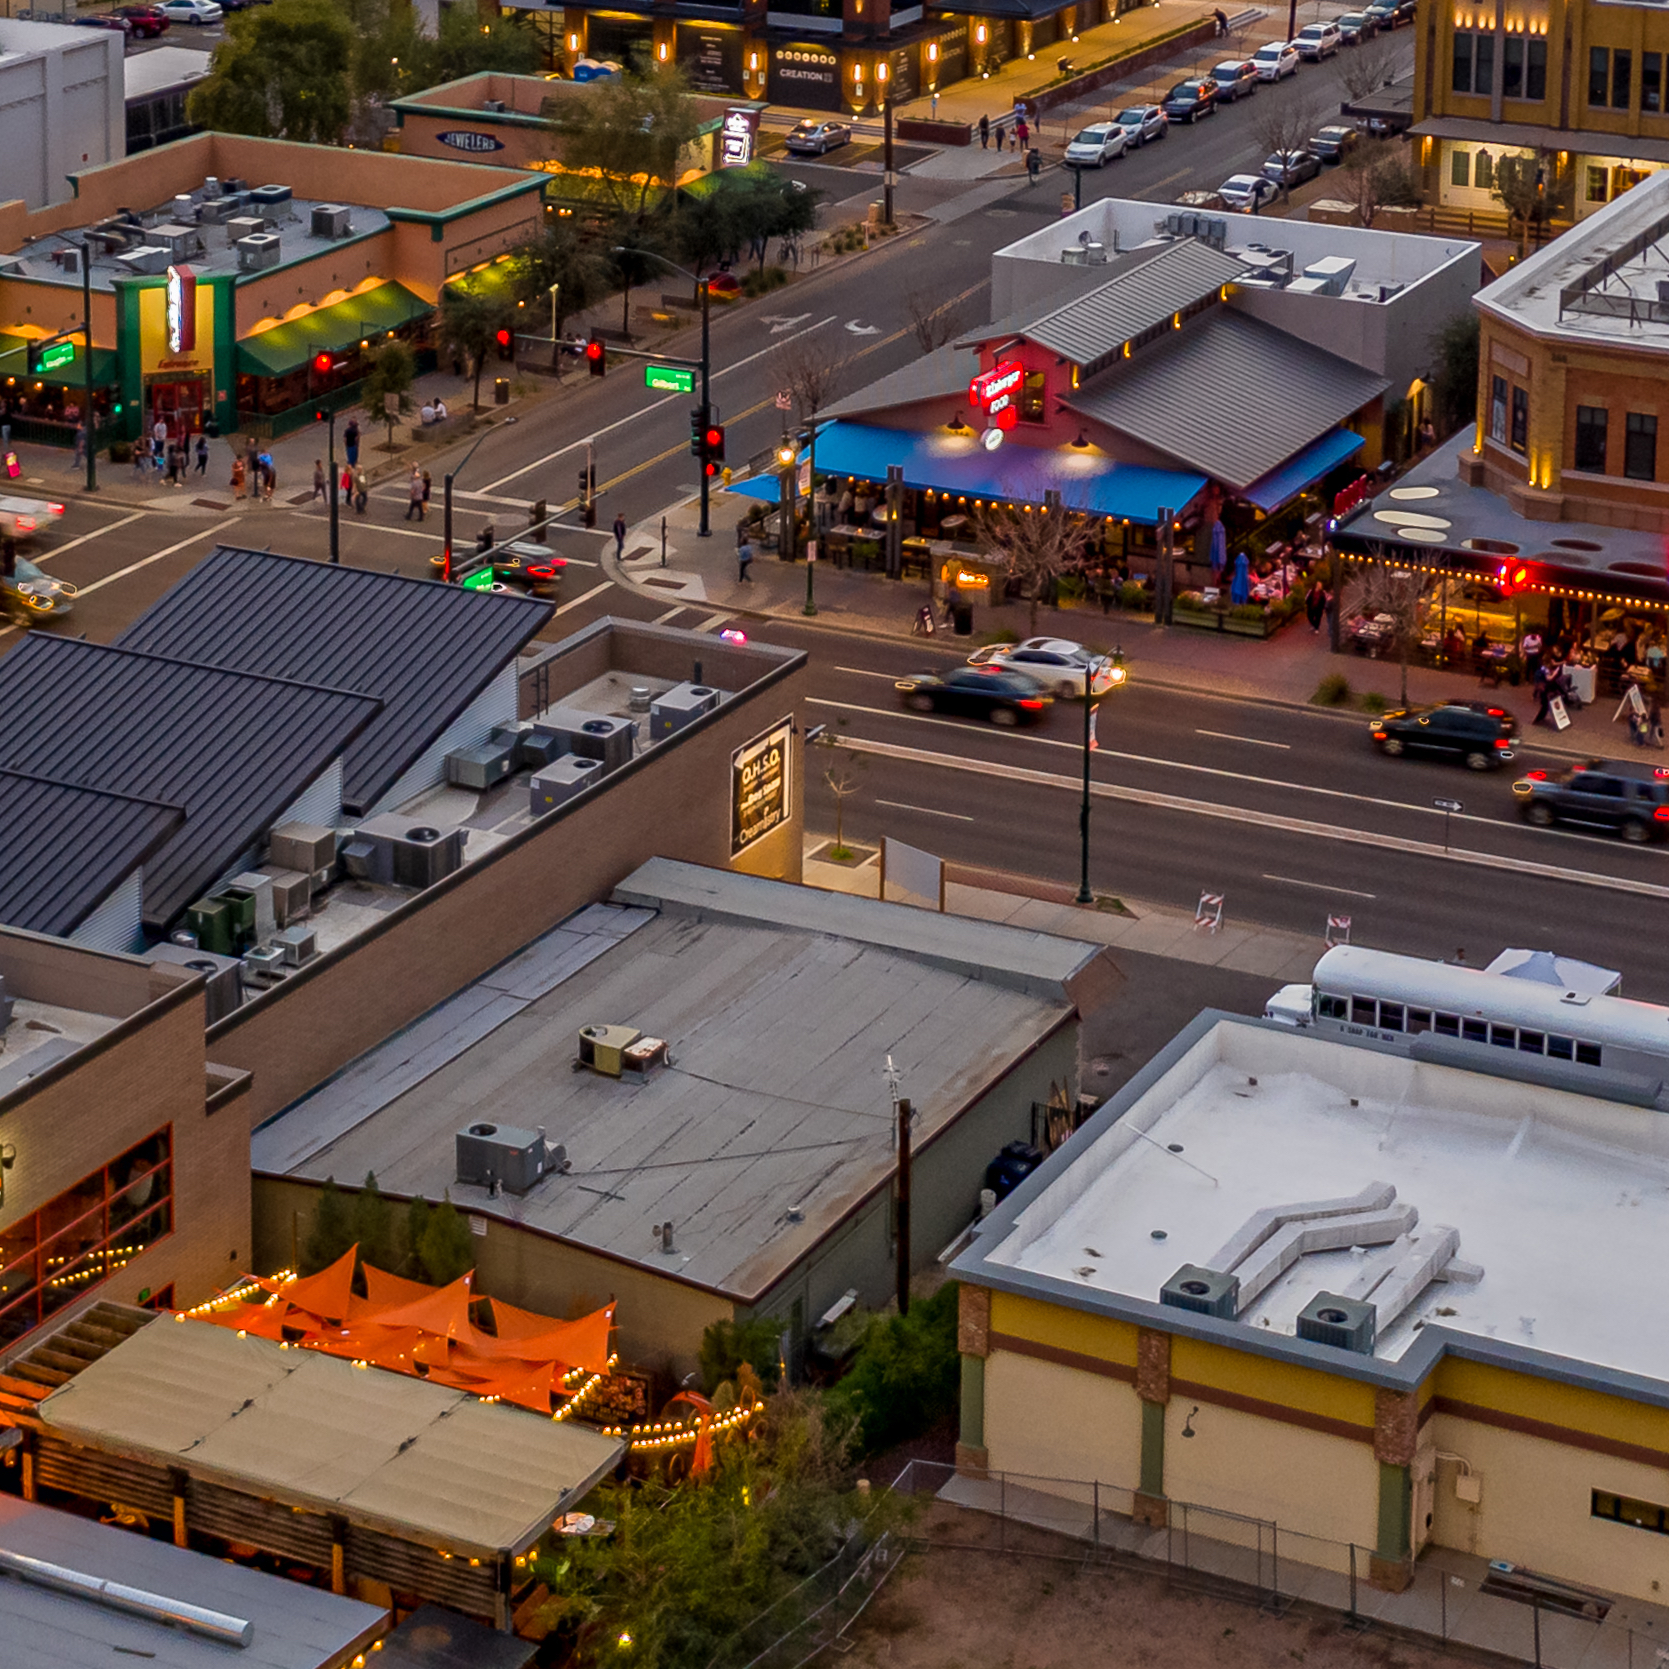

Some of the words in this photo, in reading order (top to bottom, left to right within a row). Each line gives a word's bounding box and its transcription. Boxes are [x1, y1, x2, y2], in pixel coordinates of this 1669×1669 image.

[780, 67, 823, 81] CREATION
[444, 132, 496, 151] JEWELERS
[741, 748, 781, 785] O.H.S.O.
